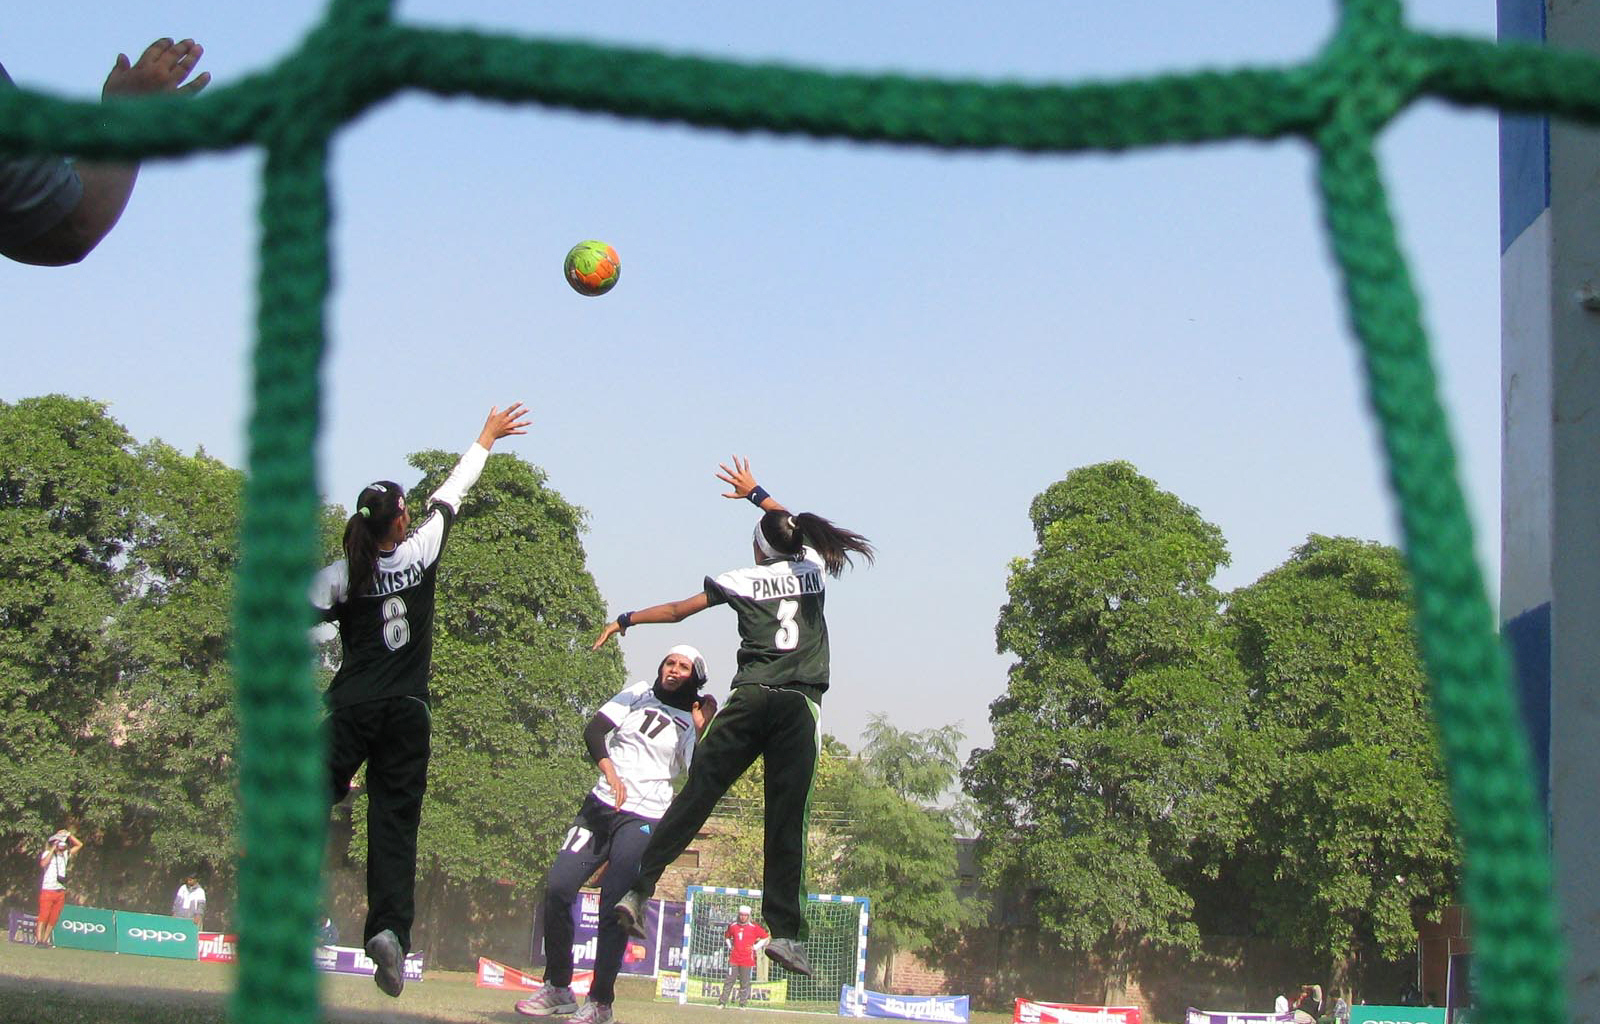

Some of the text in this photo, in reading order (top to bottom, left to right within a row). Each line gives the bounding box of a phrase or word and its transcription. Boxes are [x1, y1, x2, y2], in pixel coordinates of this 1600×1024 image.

[753, 573, 820, 599] PAKISTAN
[382, 594, 411, 652] 8
[774, 599, 800, 650] 3
[639, 709, 671, 739] 17
[561, 825, 593, 853] 17
[738, 931, 743, 941] 1
